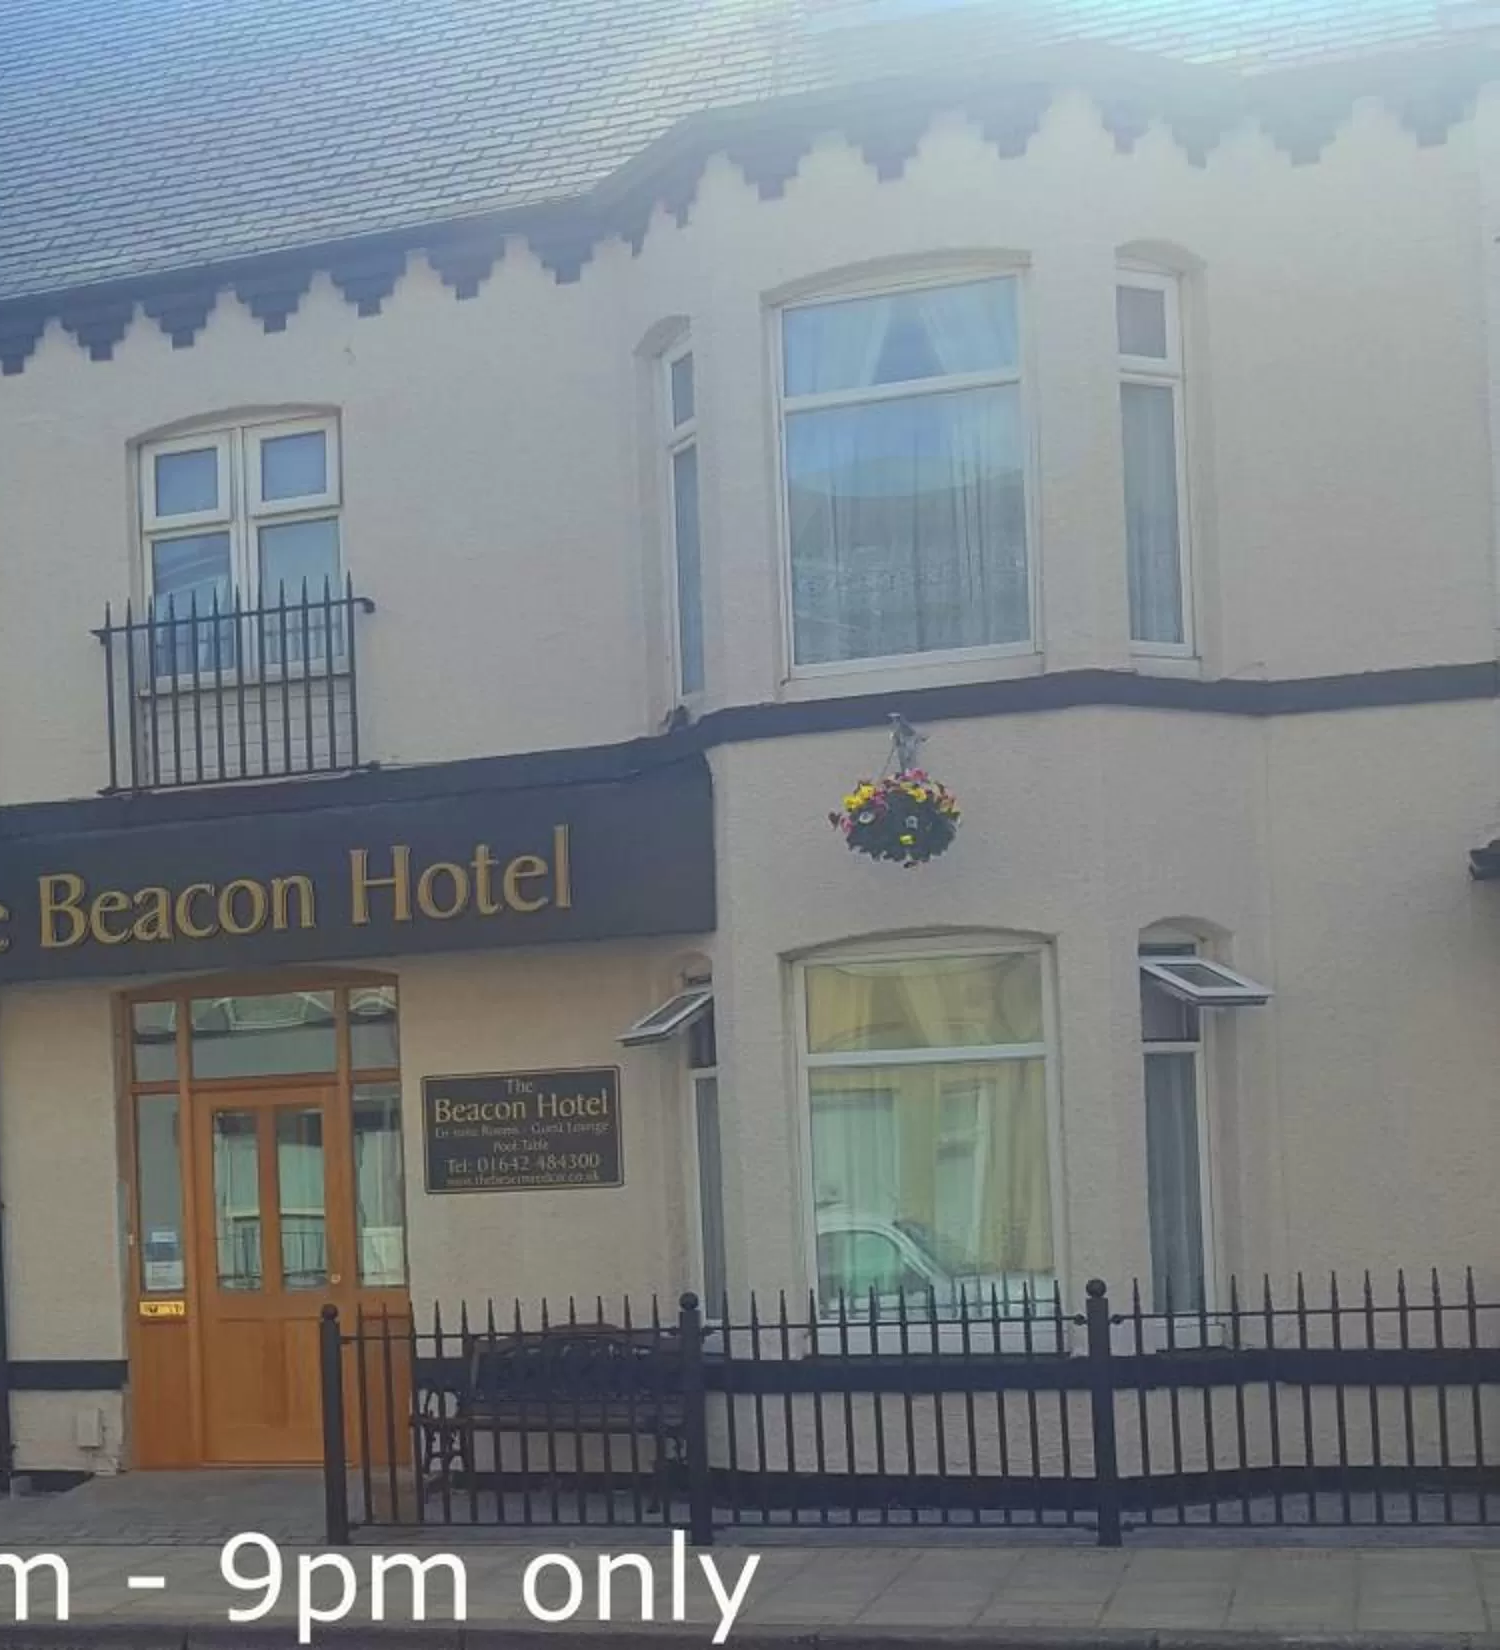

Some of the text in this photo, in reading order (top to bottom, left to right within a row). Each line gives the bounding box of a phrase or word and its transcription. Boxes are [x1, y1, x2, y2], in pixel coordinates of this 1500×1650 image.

[39, 873, 316, 950] Beacon
[350, 824, 573, 926] Hotel
[503, 1078, 534, 1095] The
[435, 1087, 609, 1124] Beacon Hotel
[445, 1151, 601, 1175] Tel: 01642 484300
